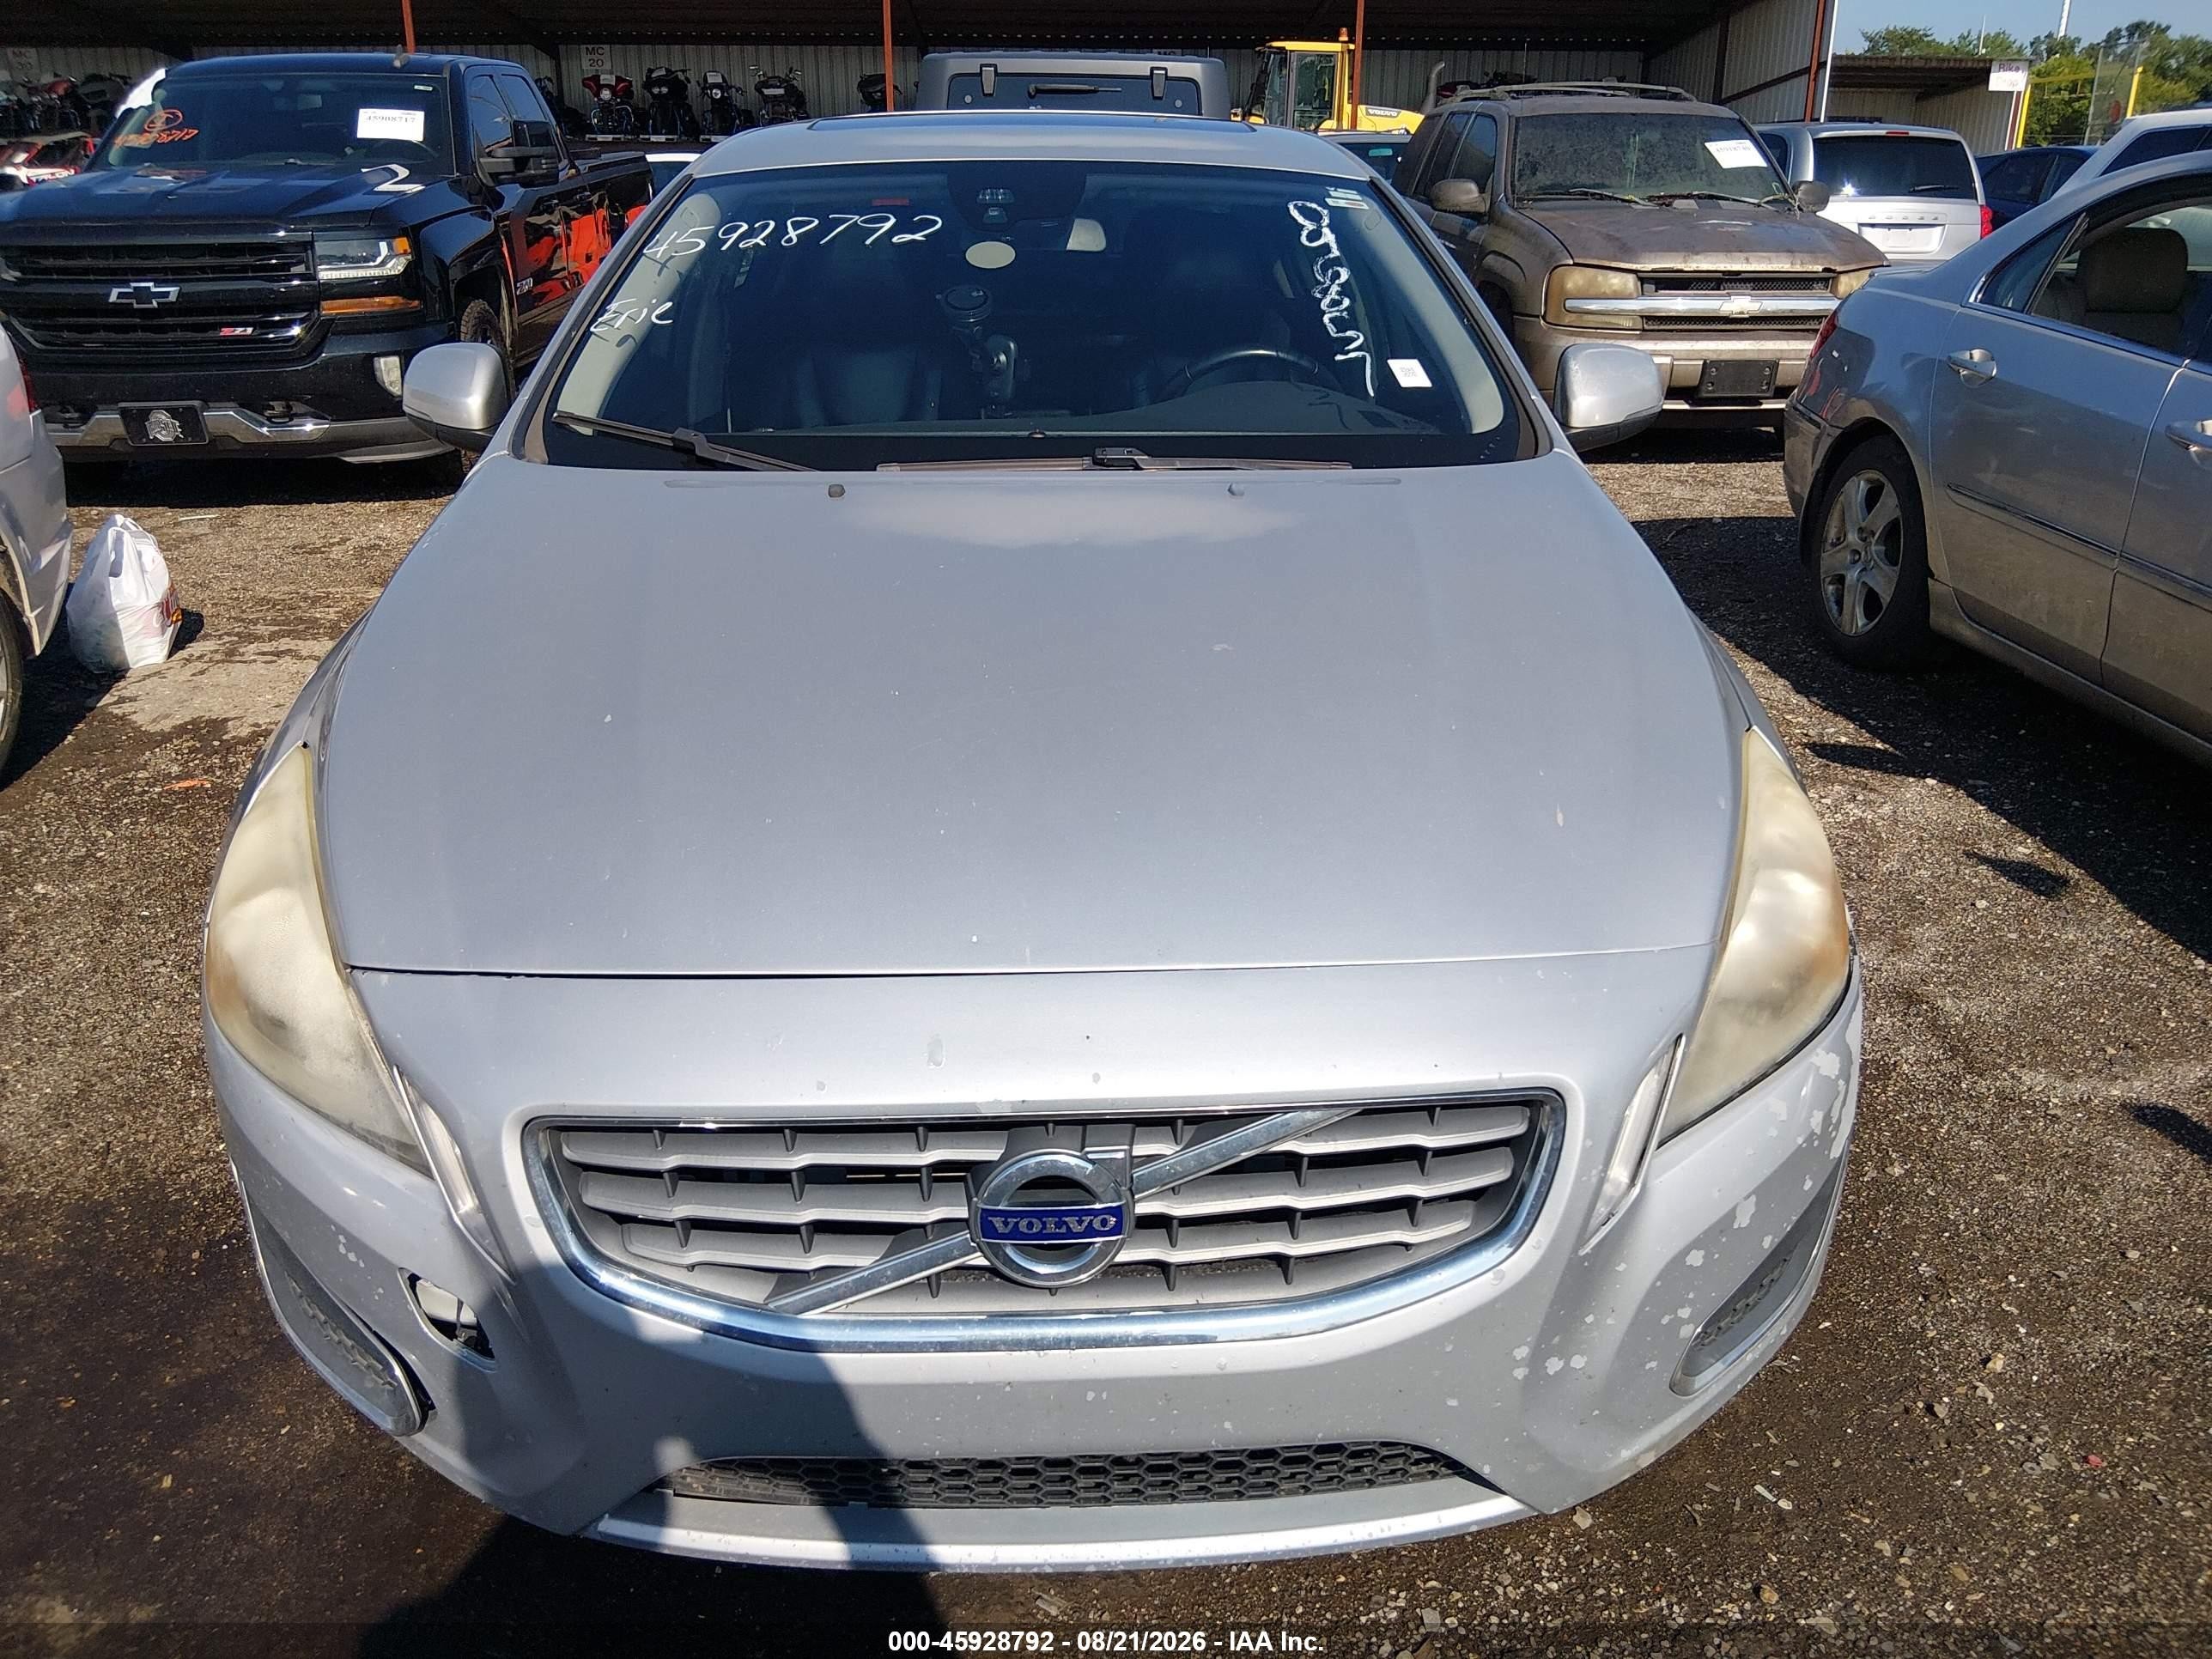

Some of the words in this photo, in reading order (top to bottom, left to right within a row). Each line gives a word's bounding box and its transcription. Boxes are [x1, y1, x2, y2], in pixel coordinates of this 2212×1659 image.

[586, 46, 605, 56] MC
[589, 58, 605, 68] 20
[1367, 108, 1398, 117] VOLVO
[361, 163, 426, 193] 2
[642, 213, 943, 258] 45928792
[988, 1214, 1117, 1234] VOLVO
